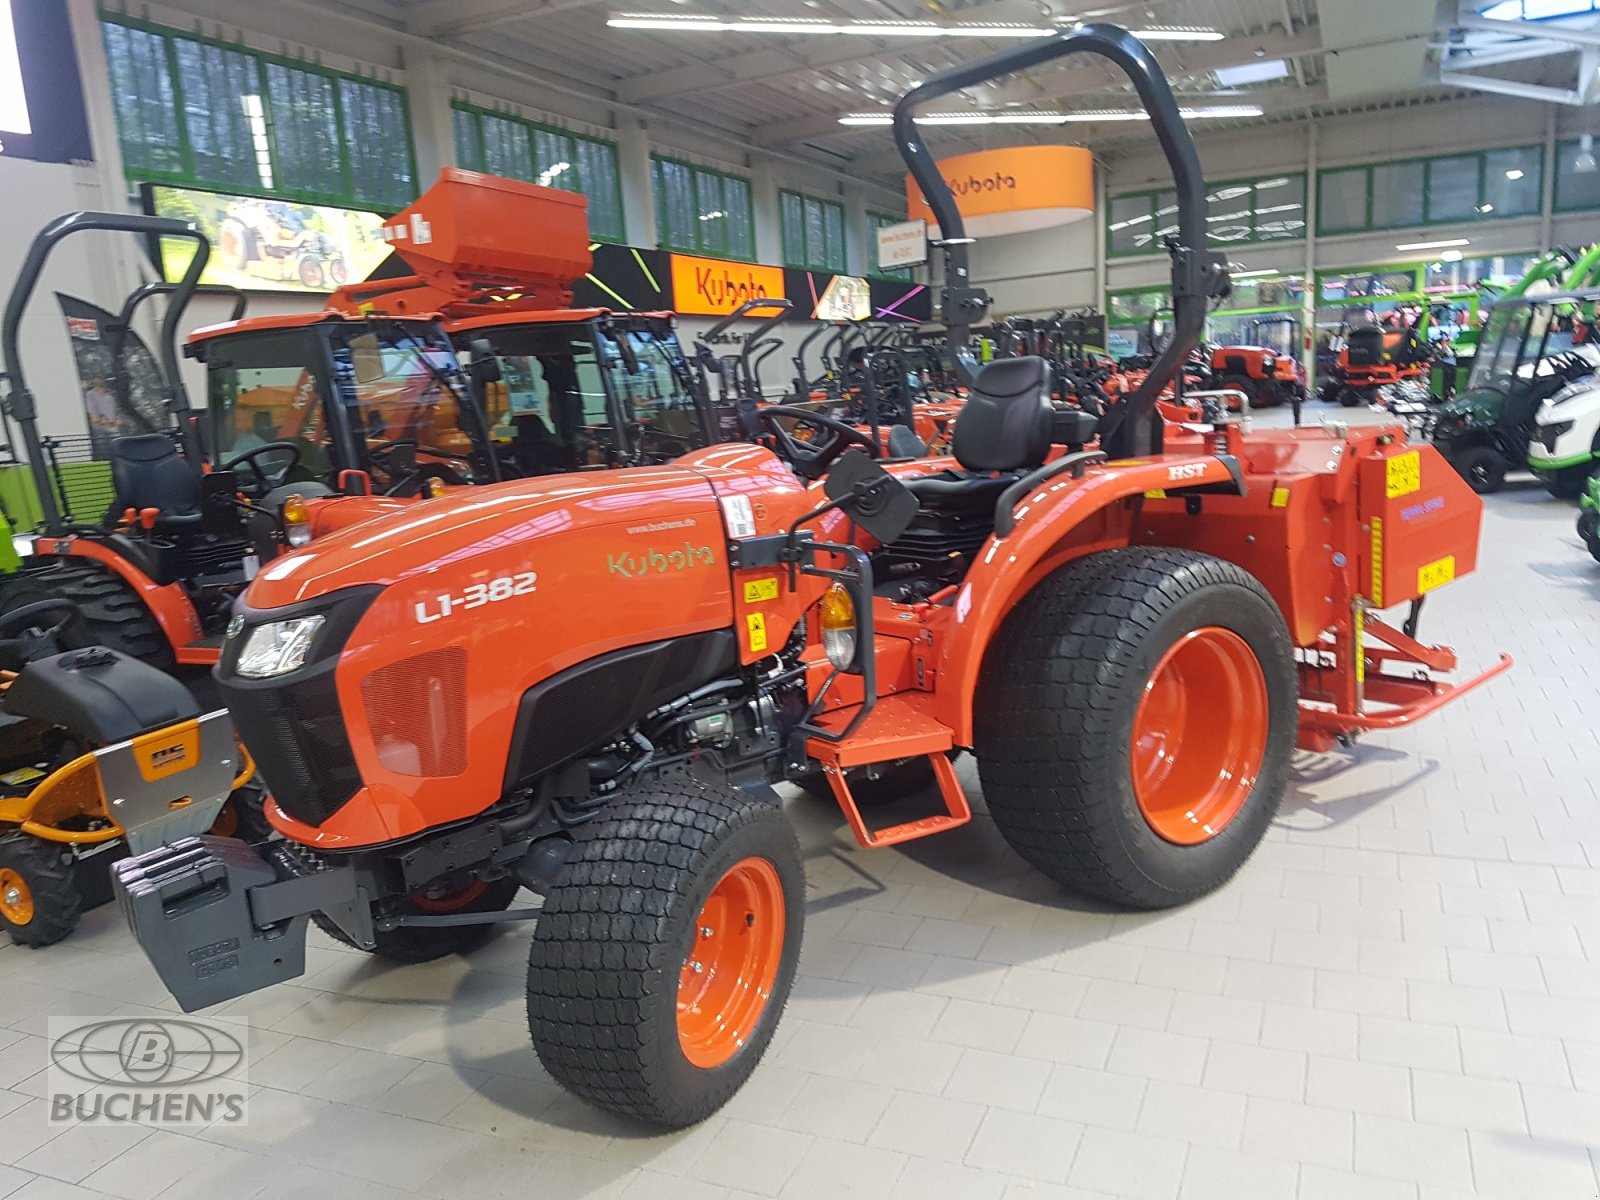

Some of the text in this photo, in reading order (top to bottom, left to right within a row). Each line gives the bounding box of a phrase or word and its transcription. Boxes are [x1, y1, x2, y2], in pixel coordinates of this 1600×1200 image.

[1168, 463, 1207, 481] HST
[606, 542, 715, 578] Kubota
[415, 571, 538, 624] L1-382
